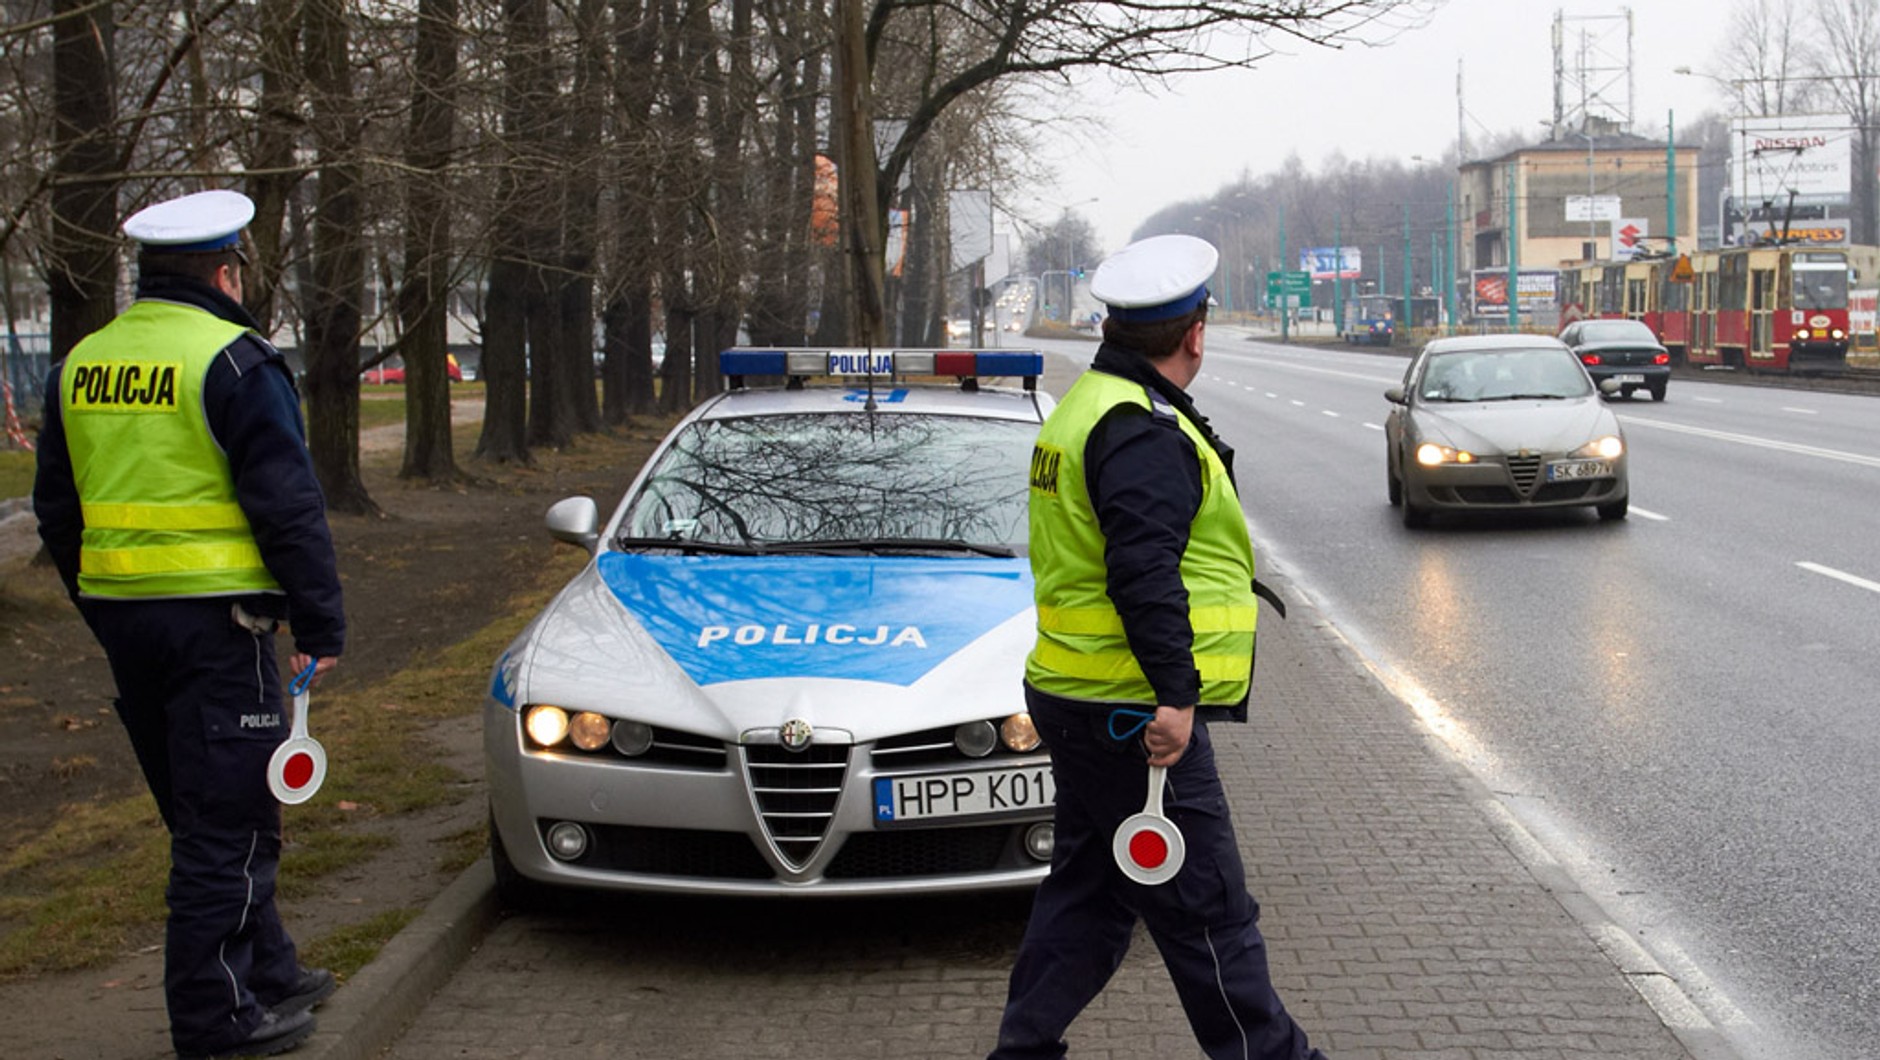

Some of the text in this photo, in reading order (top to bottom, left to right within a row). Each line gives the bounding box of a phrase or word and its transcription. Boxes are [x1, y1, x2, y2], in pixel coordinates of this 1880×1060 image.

[1754, 136, 1826, 150] NISSAN
[829, 354, 892, 374] POLICJA
[71, 364, 176, 406] POLICJA
[1554, 464, 1573, 479] SK
[697, 623, 927, 649] POLICJA
[240, 712, 280, 729] POLICJA
[878, 804, 893, 816] PL
[898, 777, 975, 817] HPP
